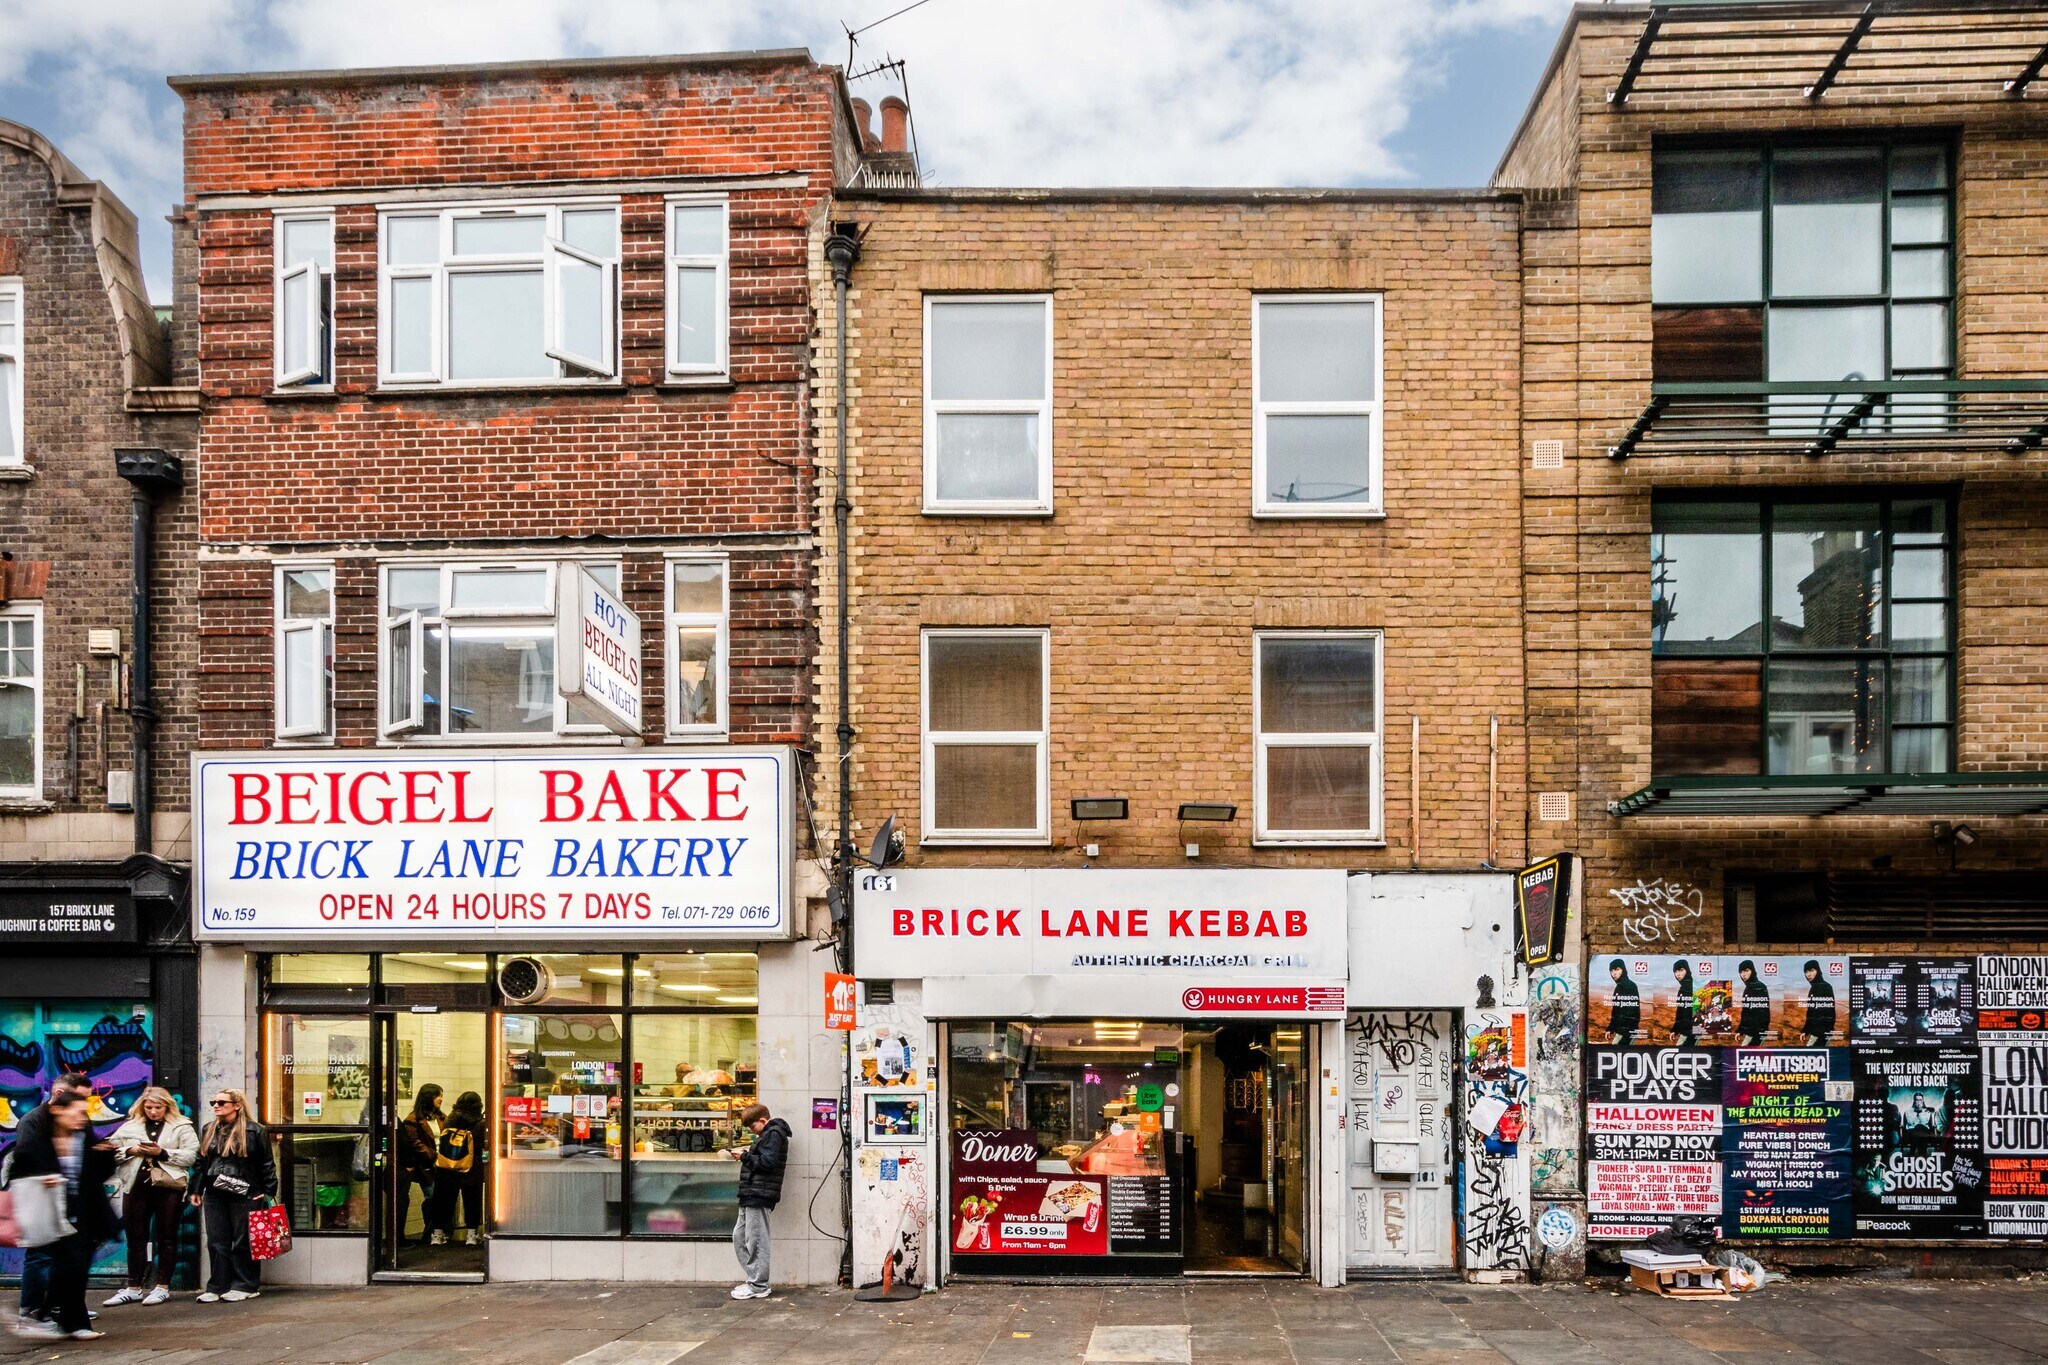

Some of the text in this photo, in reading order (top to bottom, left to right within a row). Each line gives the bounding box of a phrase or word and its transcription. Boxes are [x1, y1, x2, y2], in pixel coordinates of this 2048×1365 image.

[594, 591, 627, 638] HOT
[584, 616, 638, 687] BEIGELS
[585, 661, 638, 719] ALL NIGHT
[228, 768, 749, 826] BEIGEL BAKE
[230, 838, 748, 880] BRICK LANE BAKERY
[863, 875, 897, 892] 161
[1523, 867, 1554, 889] KEBAB
[49, 905, 115, 916] 157 BRICK LANE
[320, 893, 651, 920] OPEN 24 HOURS 7 DAYS
[740, 906, 770, 919] 0616
[39, 919, 46, 931] &
[48, 919, 80, 931] COFFEE
[82, 919, 101, 931] BAR
[892, 908, 1309, 937] BRICK LANE KEBAB
[1530, 944, 1547, 956] OPEN
[1071, 954, 1166, 966] AUTHENTIC
[1168, 954, 1255, 966] CHARCOAL
[1979, 957, 2042, 976] LONDON
[1978, 977, 2042, 990] HALLOWEEN
[1208, 994, 1298, 1004] HUNGRY LANE
[1978, 991, 2042, 1006] GUIDE.COM
[829, 1013, 853, 1022] JUST EAT
[1866, 1008, 1892, 1018] GHOST
[1863, 1017, 1895, 1027] STORIES
[328, 1055, 365, 1065] BAKE
[571, 1061, 605, 1070] LONDON
[1598, 1048, 1712, 1083] PIONEER
[1740, 1055, 1827, 1073] #MATTSBBQ
[1866, 1063, 1971, 1074] THE WEST END'S SCARIEST
[1748, 1073, 1818, 1082] HALLOWEEN
[1888, 1075, 1948, 1087] SHOW IS BACK!
[1610, 1080, 1695, 1100] PLAYS
[1752, 1096, 1810, 1106] NIGHT OF
[1596, 1108, 1714, 1121] HALLOWEEN
[1727, 1107, 1746, 1117] THE
[1749, 1107, 1791, 1117] RAVING
[1794, 1107, 1823, 1117] DEAD
[647, 1120, 674, 1130] HOT
[676, 1120, 708, 1130] SALT
[1636, 1123, 1673, 1131] DRESS
[1595, 1135, 1715, 1149] SUN 2ND NOV
[961, 1137, 1037, 1163] Doner
[1595, 1148, 1715, 1160] 3PM-11PM E1 LDN
[1889, 1151, 1946, 1173] GHOST
[1597, 1164, 1705, 1174] PIONEER SUPA TERMINAL
[977, 1176, 1000, 1184] Chips,
[1000, 1176, 1023, 1184] salad,
[1597, 1174, 1673, 1183] COLDSTEPS SPIDEY
[1883, 1171, 1954, 1192] STORIES
[1990, 1171, 2041, 1182] HALLOWEEN
[1599, 1183, 1667, 1192] WIGMAN PETCHY
[1756, 1180, 1813, 1188] MISTA HOOLI
[1616, 1193, 1640, 1201] DIMPZ
[1648, 1193, 1669, 1201] LAWZ
[1676, 1194, 1695, 1202] PURE
[1696, 1194, 1719, 1203] VIBES
[1881, 1196, 1957, 1204] BOOK NOW FOR HALLOWEEN
[1601, 1202, 1623, 1210] LOYAL
[1989, 1204, 2045, 1217] BOOK YOUR
[1004, 1213, 1064, 1222] Wrap & Drink
[1740, 1215, 1829, 1224] BOXPARK CROYDON
[1740, 1226, 1829, 1234] WWW.MATTSBBQ.CO.UK
[1866, 1220, 1911, 1230] Peacock
[1004, 1226, 1048, 1236] £6.99
